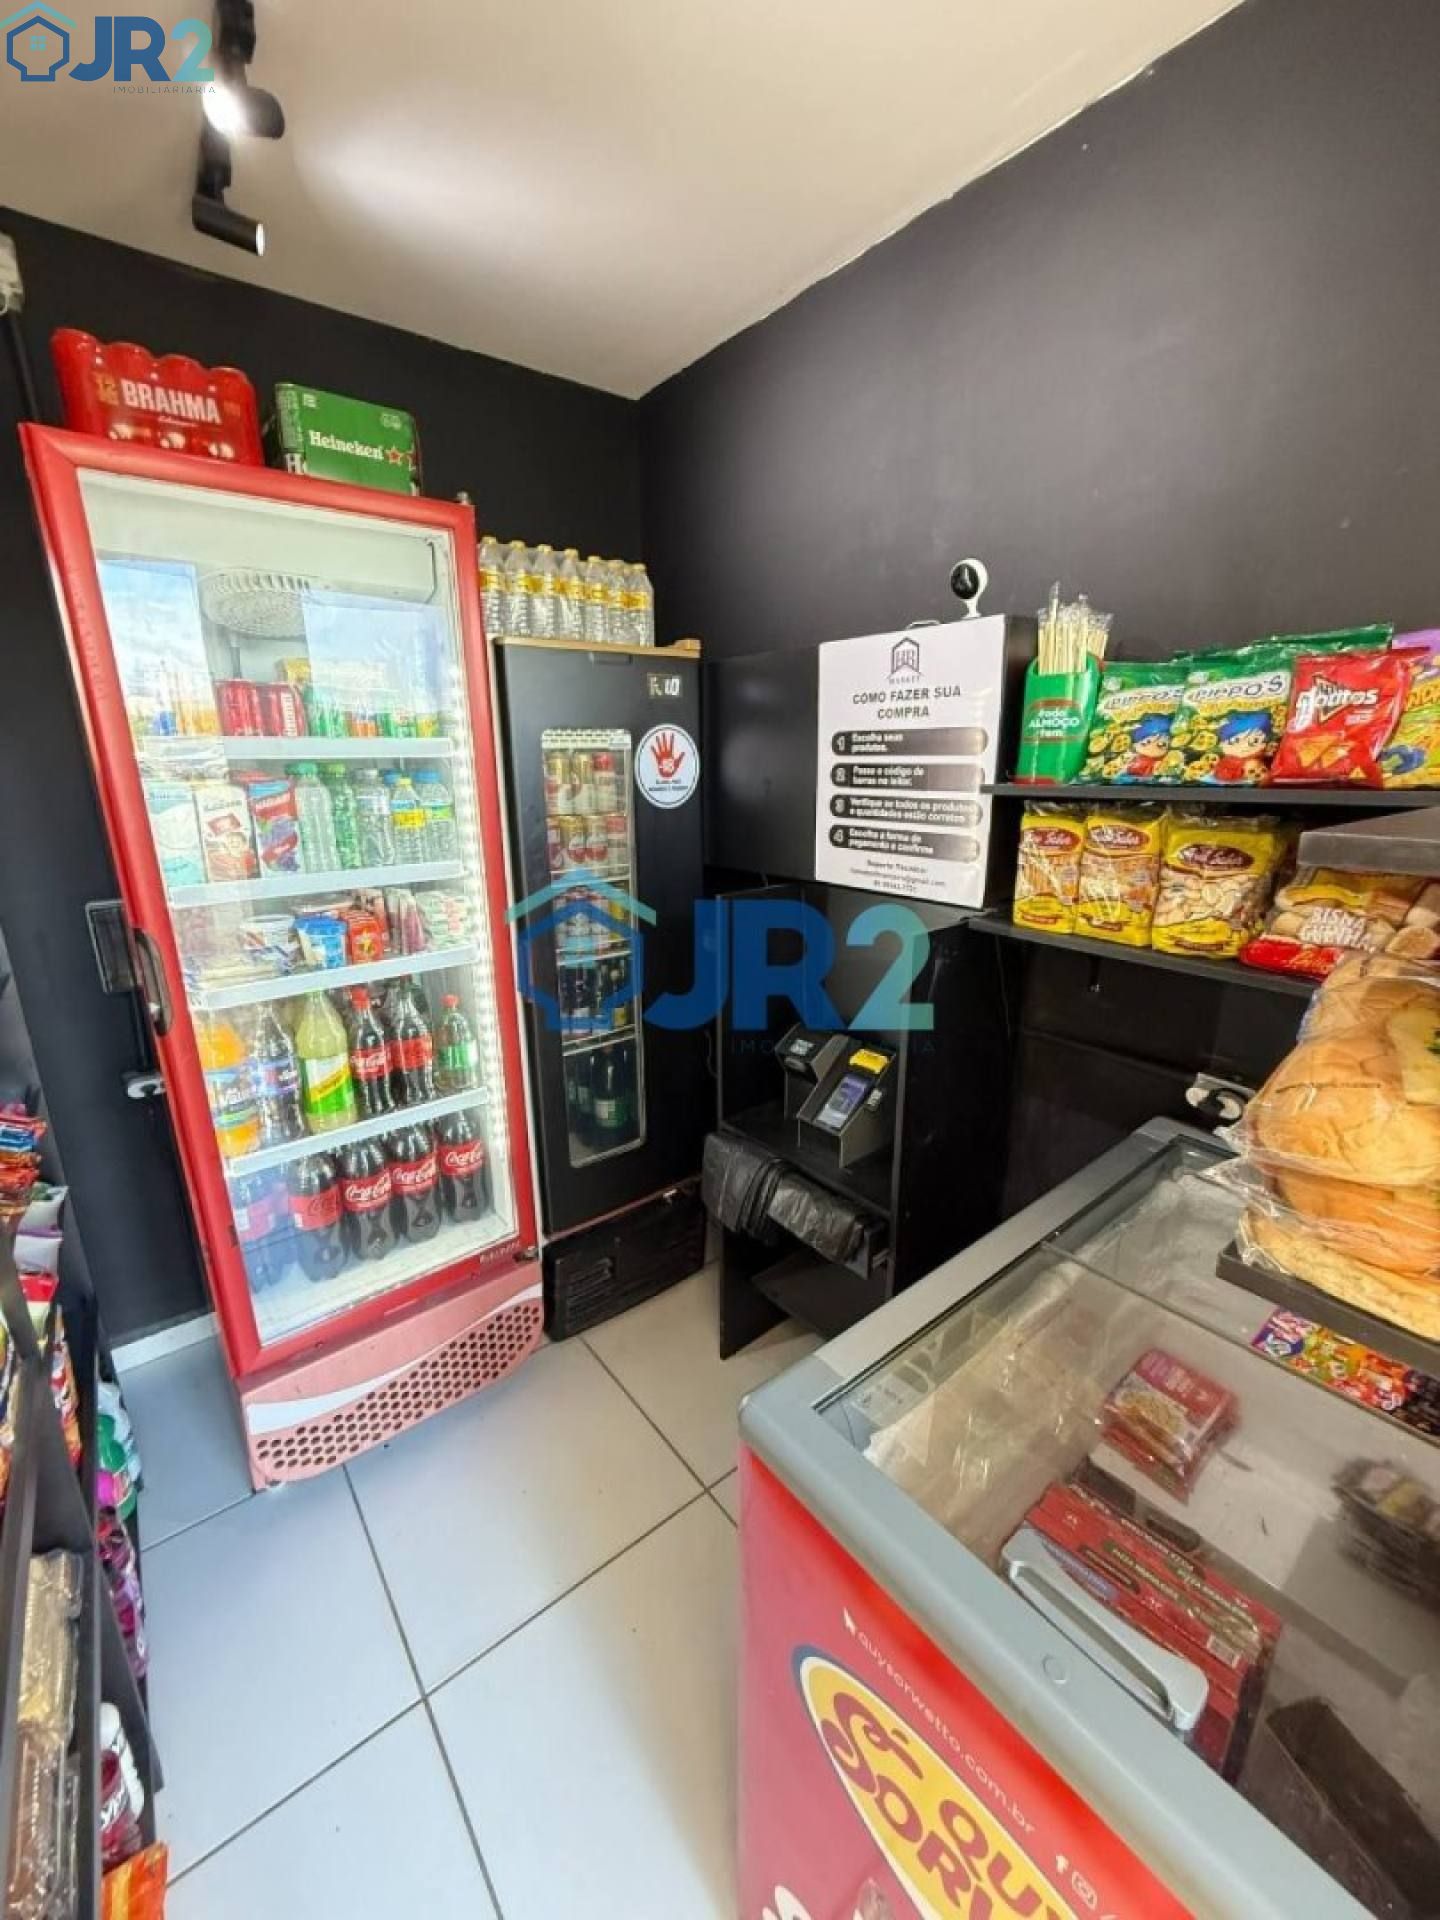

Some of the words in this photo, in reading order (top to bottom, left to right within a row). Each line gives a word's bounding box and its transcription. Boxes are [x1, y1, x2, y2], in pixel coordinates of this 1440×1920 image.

[120, 378, 223, 425] BRAHMA
[309, 430, 385, 460] Heineken
[853, 691, 886, 704] COMO
[890, 687, 929, 702] FAZER
[934, 685, 961, 698] SUA
[877, 705, 929, 719] COMPRA
[938, 1798, 1063, 1920] QU
